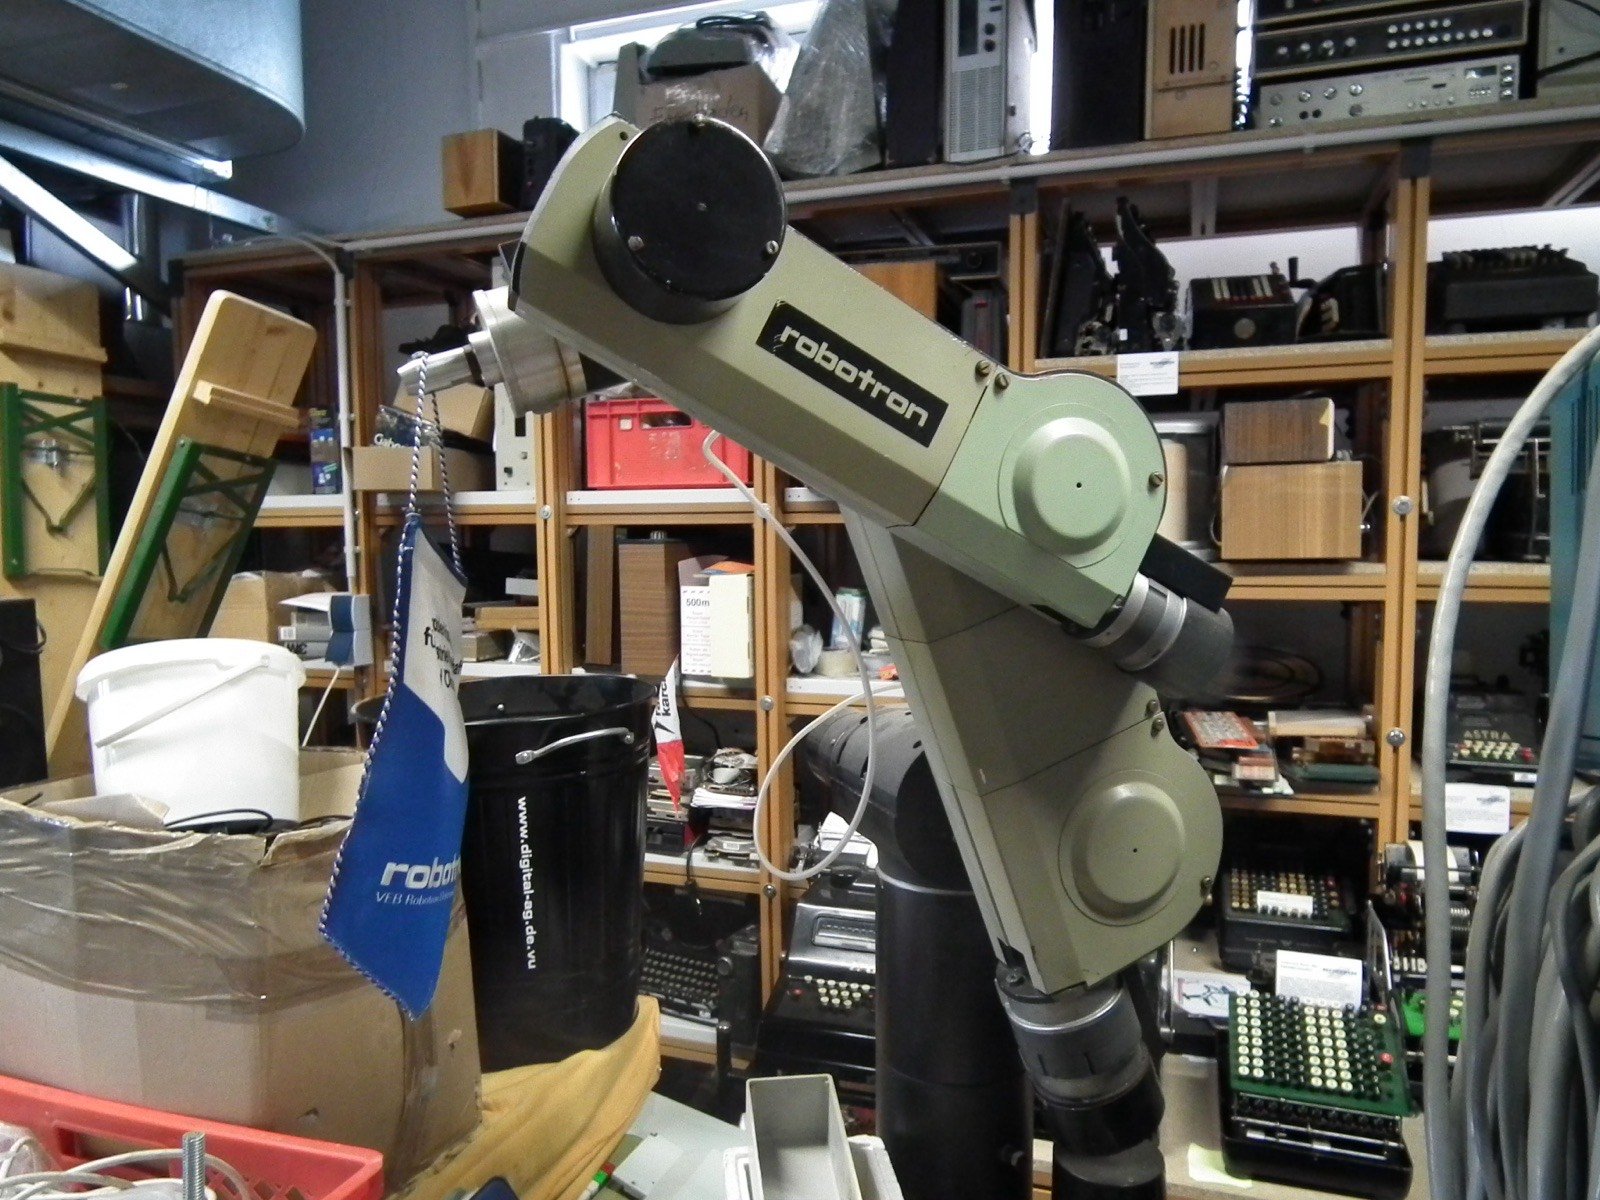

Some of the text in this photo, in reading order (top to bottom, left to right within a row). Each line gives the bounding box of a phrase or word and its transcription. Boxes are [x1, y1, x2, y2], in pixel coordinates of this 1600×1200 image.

[779, 325, 929, 427] robotron
[1463, 729, 1512, 741] ASTRA
[517, 796, 537, 970] www.digital-ag.de.vu
